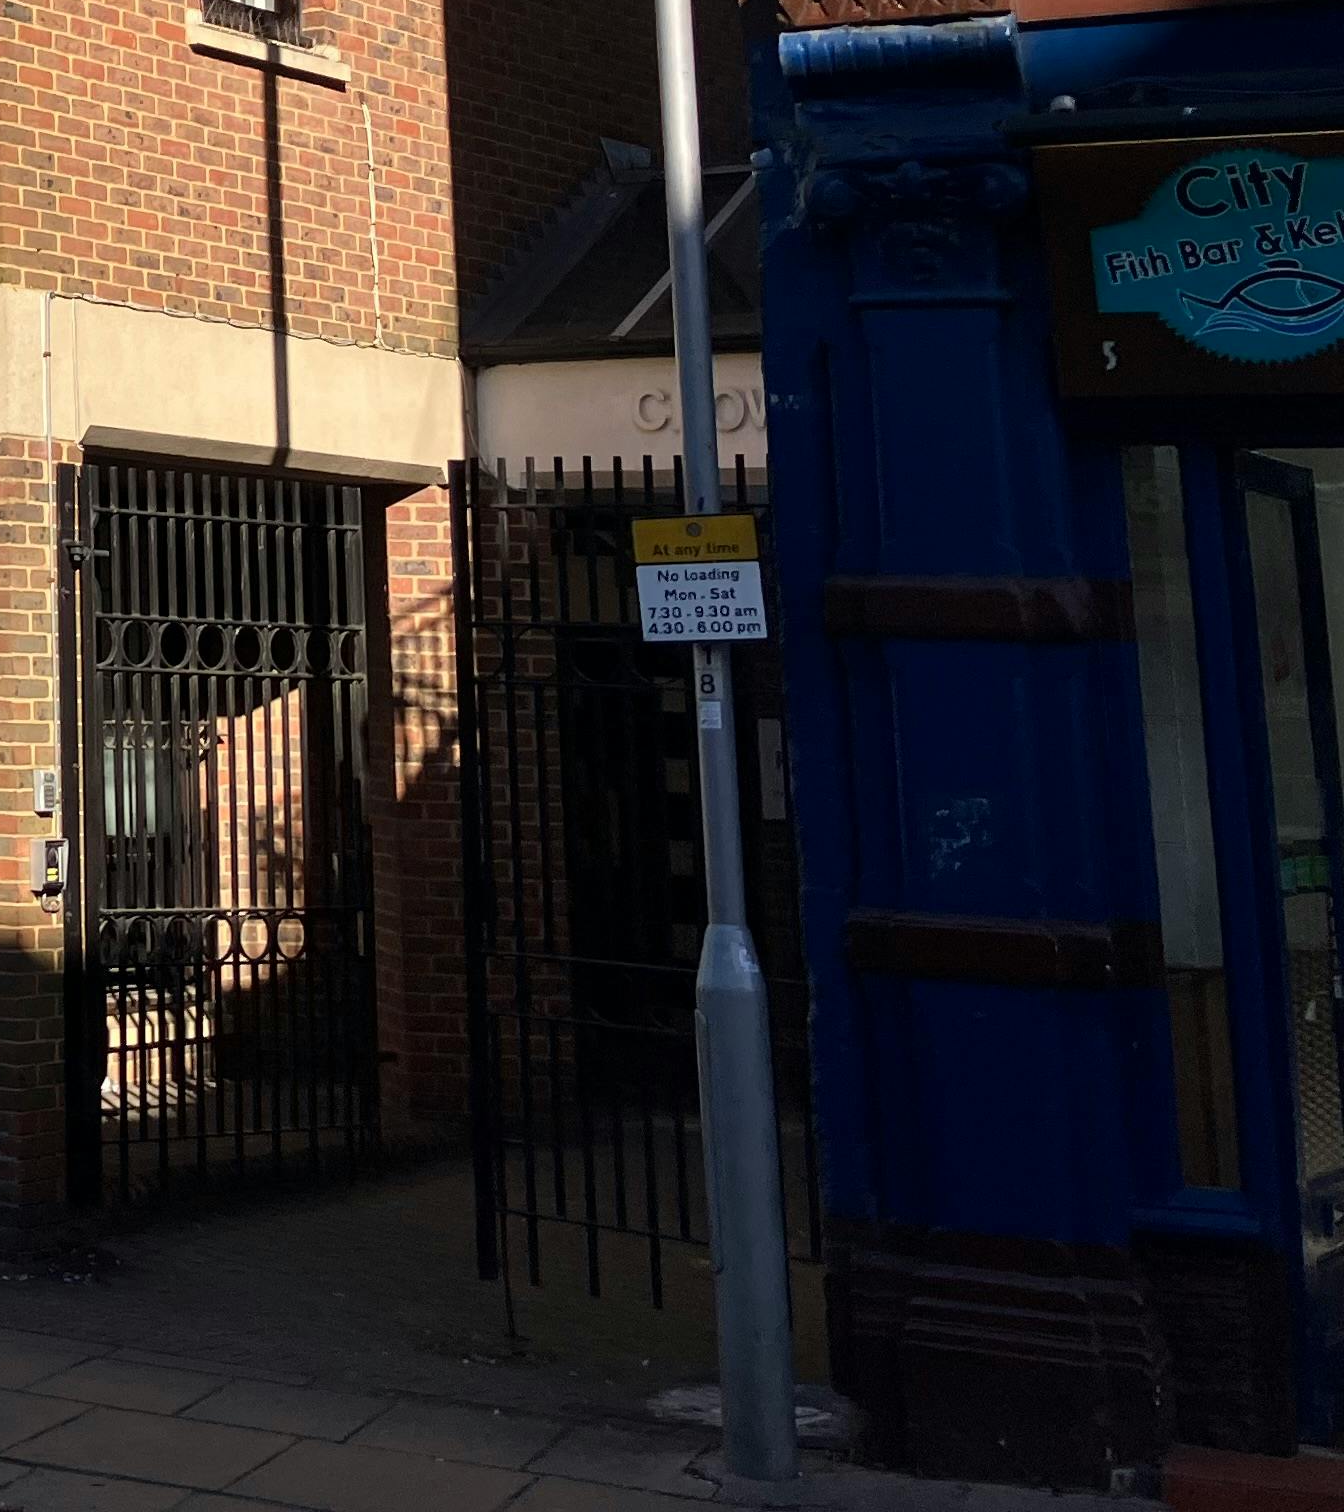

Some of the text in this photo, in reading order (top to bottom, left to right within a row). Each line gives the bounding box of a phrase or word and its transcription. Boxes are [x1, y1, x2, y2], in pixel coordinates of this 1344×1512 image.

[1175, 159, 1307, 217] City
[1105, 246, 1173, 284] Fish
[1177, 239, 1242, 270] Bar
[1254, 223, 1284, 256] &
[654, 543, 740, 557] At any time
[657, 569, 740, 582] No loading
[664, 589, 696, 601] Mon
[710, 588, 736, 599] Sat
[735, 607, 757, 617] am
[738, 622, 761, 634] pm
[701, 674, 715, 694] 8
